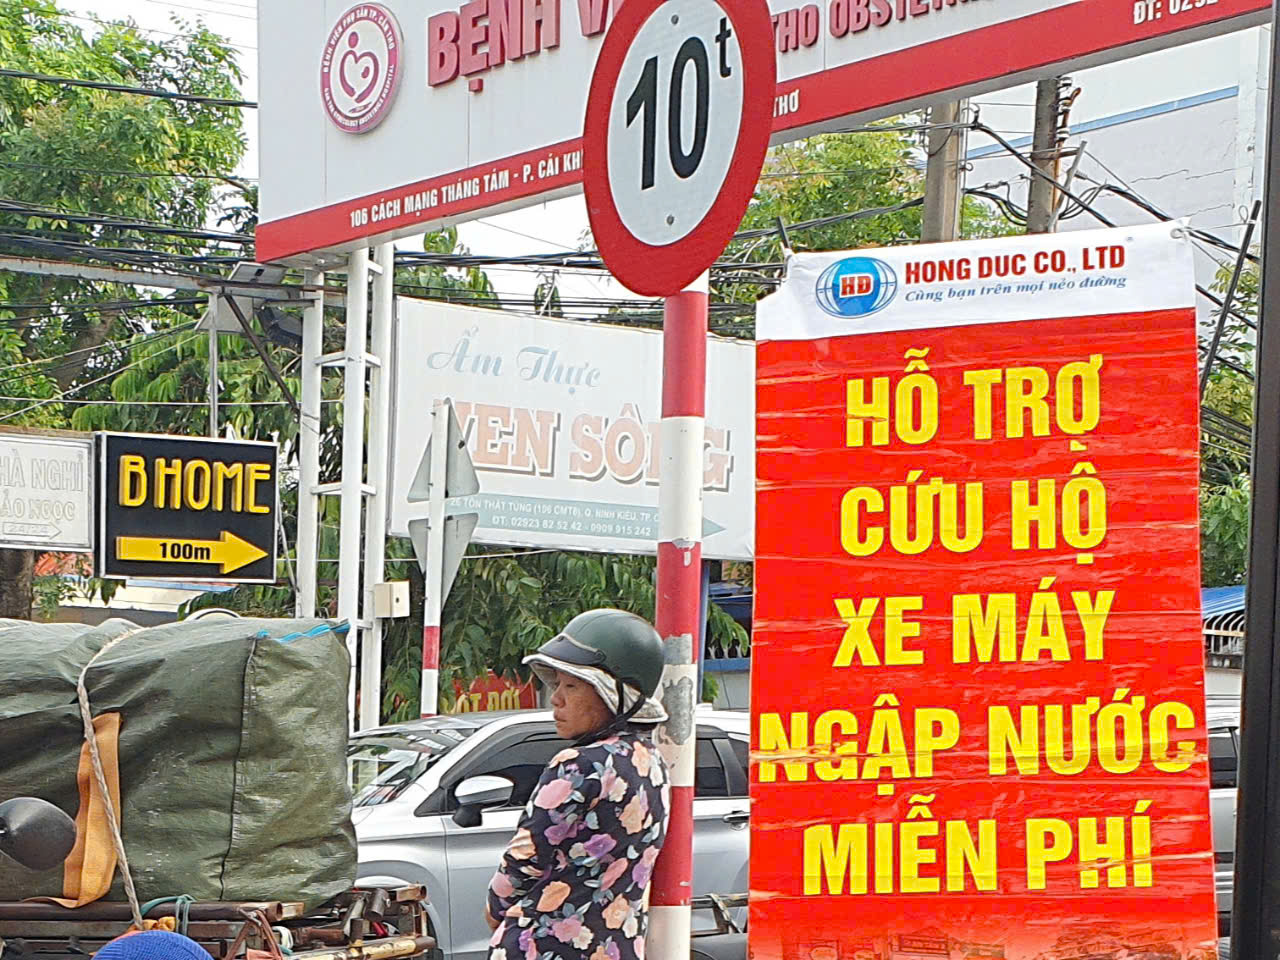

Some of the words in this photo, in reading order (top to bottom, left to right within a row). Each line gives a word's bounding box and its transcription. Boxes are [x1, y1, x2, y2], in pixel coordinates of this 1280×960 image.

[770, 5, 819, 53] HO
[350, 208, 368, 228] 106
[371, 198, 401, 223] CÁCH
[404, 191, 438, 217] MẠNG
[441, 178, 480, 204] THÁNG
[483, 168, 510, 193] TÁM
[522, 163, 534, 183] P.
[538, 153, 560, 178] CÁI
[563, 149, 584, 172] KH
[905, 257, 970, 285] HONG
[978, 251, 1026, 279] DUC
[1034, 248, 1077, 274] CO.,
[1083, 245, 1125, 271] LTD
[905, 288, 943, 303] Cùng
[948, 286, 976, 301] bạn
[980, 281, 1011, 297] trên
[1016, 280, 1043, 296] mọi
[1049, 275, 1075, 290] nẻo
[1080, 274, 1127, 290] đường
[426, 324, 505, 378] Ẩm
[516, 346, 601, 395] Thực
[846, 347, 939, 448] HỖ
[963, 354, 1104, 451] TRỢ
[31, 450, 84, 492] NGHỈ
[570, 402, 734, 493] SÔG
[159, 543, 211, 560] 100m
[840, 469, 984, 557] CỨU
[1011, 461, 1108, 565] HỘ
[832, 596, 924, 668] XE
[952, 577, 1116, 664] MÁY
[758, 693, 961, 796] NGẬP
[988, 687, 1198, 777] NƯỚC
[803, 793, 998, 897] MIỄN
[1025, 799, 1154, 892] PHÍ
